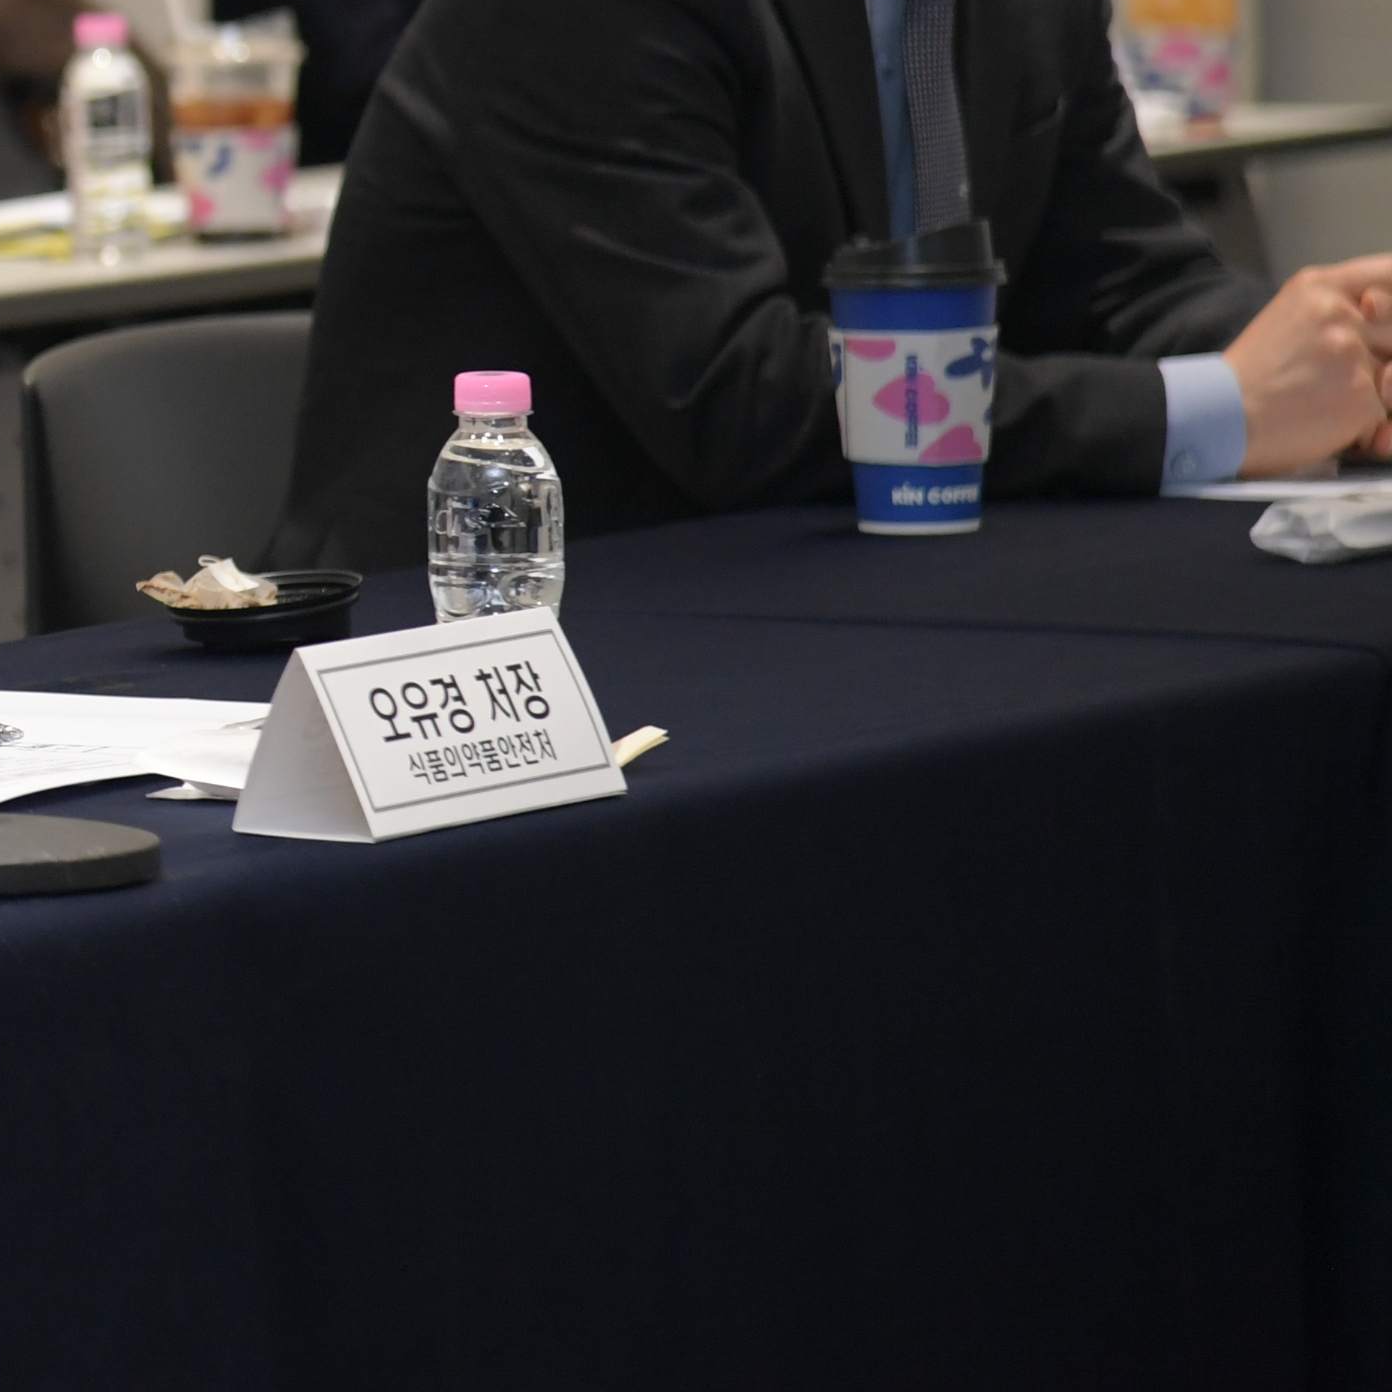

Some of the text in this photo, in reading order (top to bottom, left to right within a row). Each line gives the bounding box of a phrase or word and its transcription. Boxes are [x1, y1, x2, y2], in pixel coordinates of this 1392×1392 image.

[368, 660, 552, 743] 오유경 처장
[408, 727, 559, 786] 식품의약품안전처
